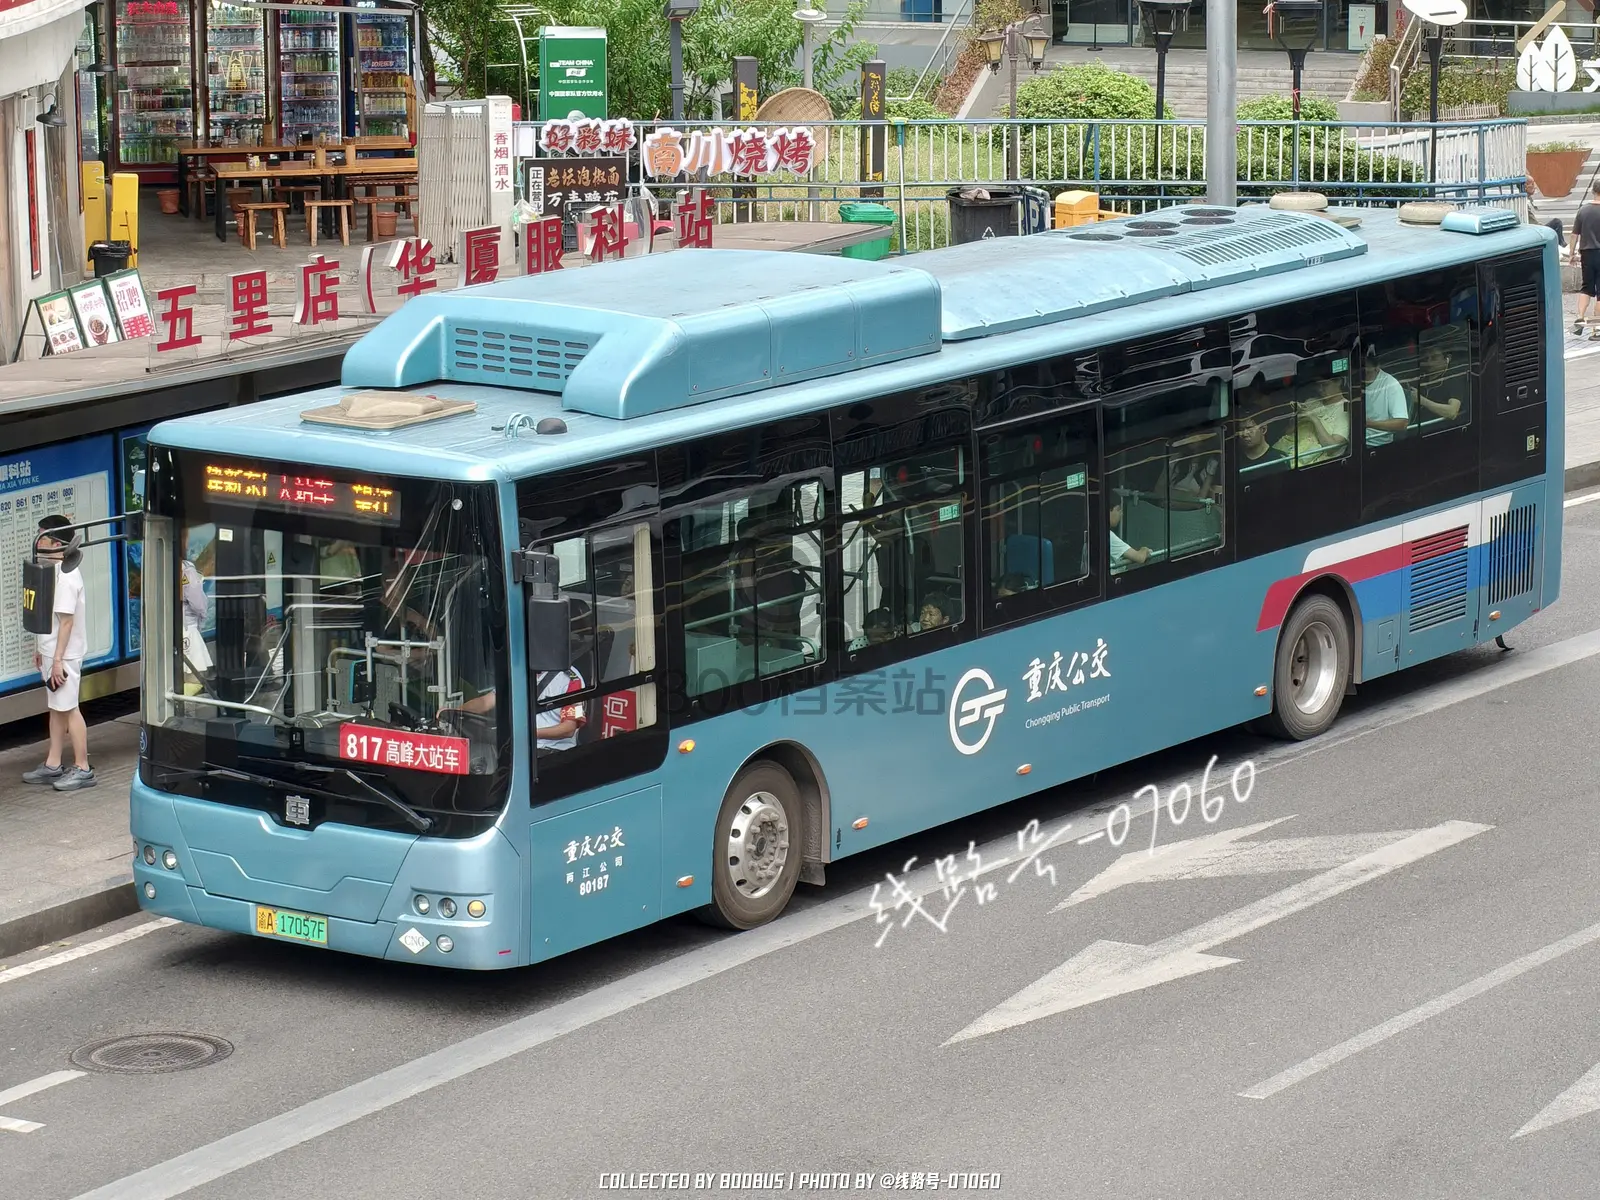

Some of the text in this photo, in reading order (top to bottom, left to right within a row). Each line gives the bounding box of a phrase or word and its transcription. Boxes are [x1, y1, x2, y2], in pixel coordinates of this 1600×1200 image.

[545, 123, 633, 151] 好彩妹
[645, 129, 815, 176] 南川烧烤
[493, 132, 510, 190] 香烟酒水
[1022, 638, 1112, 702] 重庆公交
[1025, 693, 1111, 729] Chongqing Public Transport
[346, 733, 460, 772] 817 高峰大站车
[563, 826, 626, 864] 重庆公交
[579, 874, 609, 896] 80187
[404, 934, 426, 948] CNG
